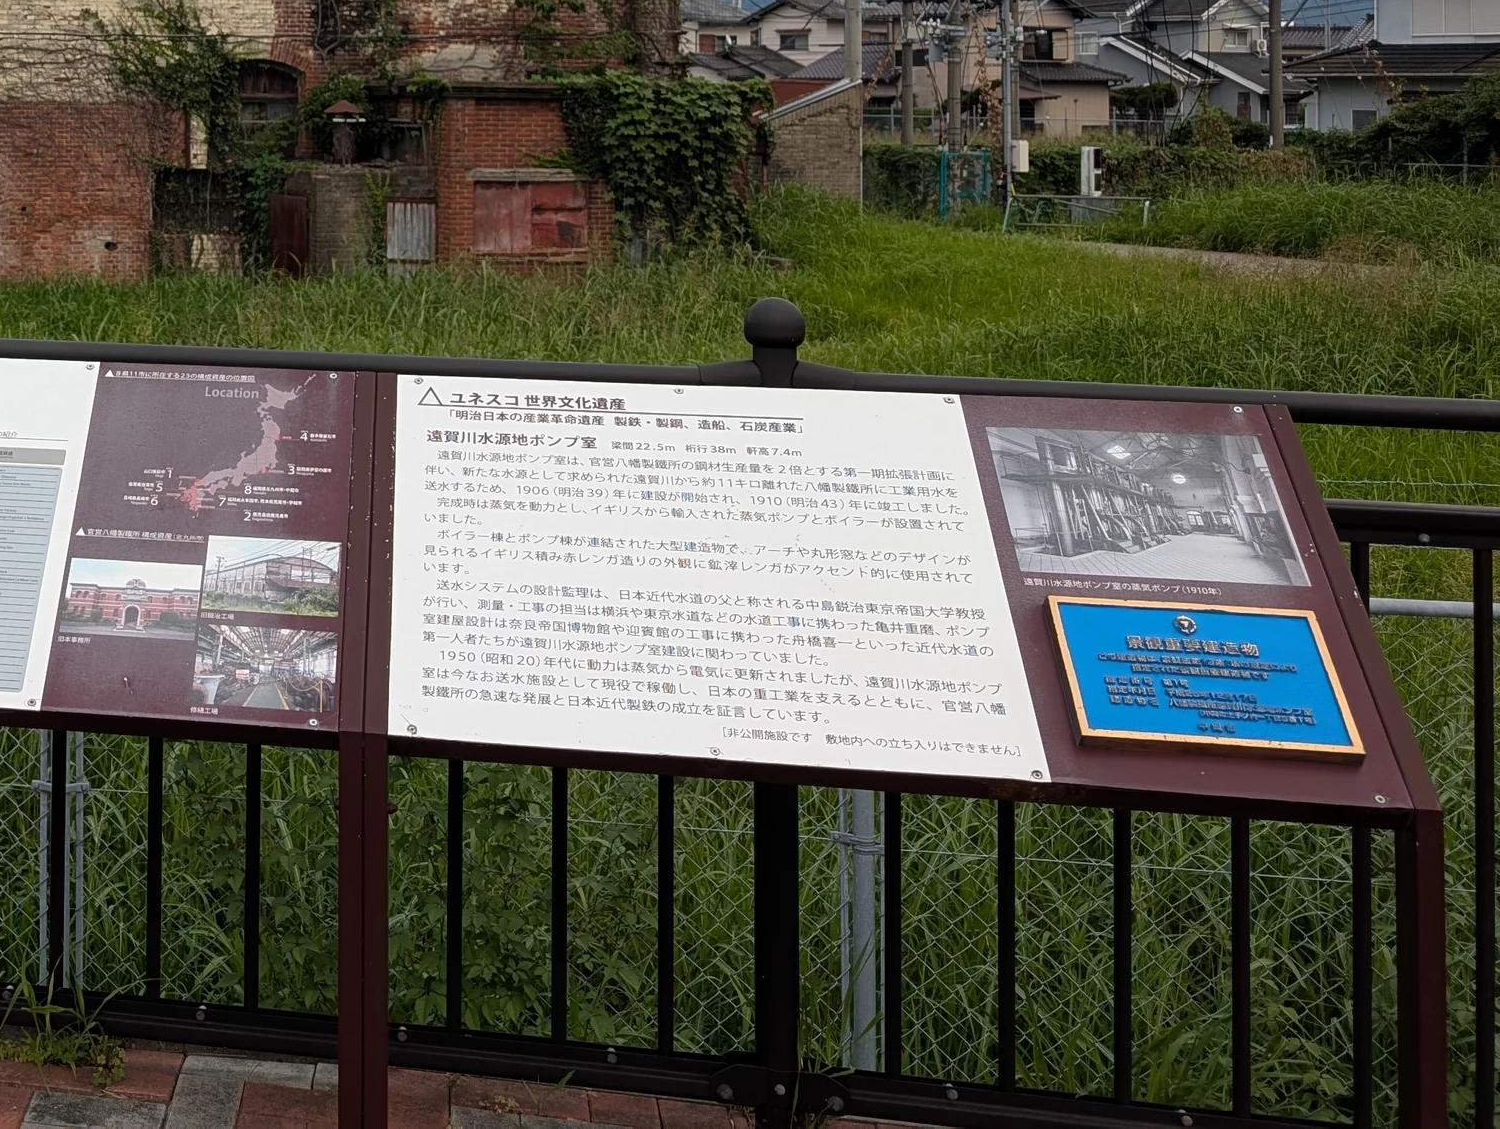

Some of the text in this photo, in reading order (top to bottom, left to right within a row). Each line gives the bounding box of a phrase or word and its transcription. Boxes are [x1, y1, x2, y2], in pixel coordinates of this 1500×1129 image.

[204, 386, 259, 399] Location
[449, 392, 626, 411] ユネスコ 世界文化遺産
[449, 409, 803, 433] 「明治日本の産業革命遺産 製鉄・製鋼、造船、石炭産業」
[299, 432, 308, 441] 4
[426, 429, 802, 457] 遠賀川水源地ポンプ室 梁間22.5m 桁行38m 軒高7.4m
[166, 469, 172, 479] 1
[287, 465, 295, 475] 3
[154, 482, 163, 492] 5
[243, 485, 252, 495] 8
[149, 496, 159, 506] 6
[217, 497, 227, 507] 7
[242, 511, 252, 521] 2
[424, 513, 482, 526] いました。
[437, 496, 964, 532] 完成時は蒸気を動力とし、イギリスから輸入された蒸気ポンプとボイラーが設置されて
[437, 529, 971, 566] ボイラー棟とポンプ棟が連結された大型建造物で、アーチや丸形窓などのデザインが
[423, 562, 469, 575] います。
[56, 634, 91, 645] 旧本事務所
[422, 630, 828, 667] 第一人者たちが遠賀川水源地ポンプ室建設に関わっていました。
[1125, 635, 1260, 658] 景観重要建造物
[422, 666, 1006, 715] 室は今なお送水施設として現役で稼働し、日本の重工業を支えるとともに、官営八幡
